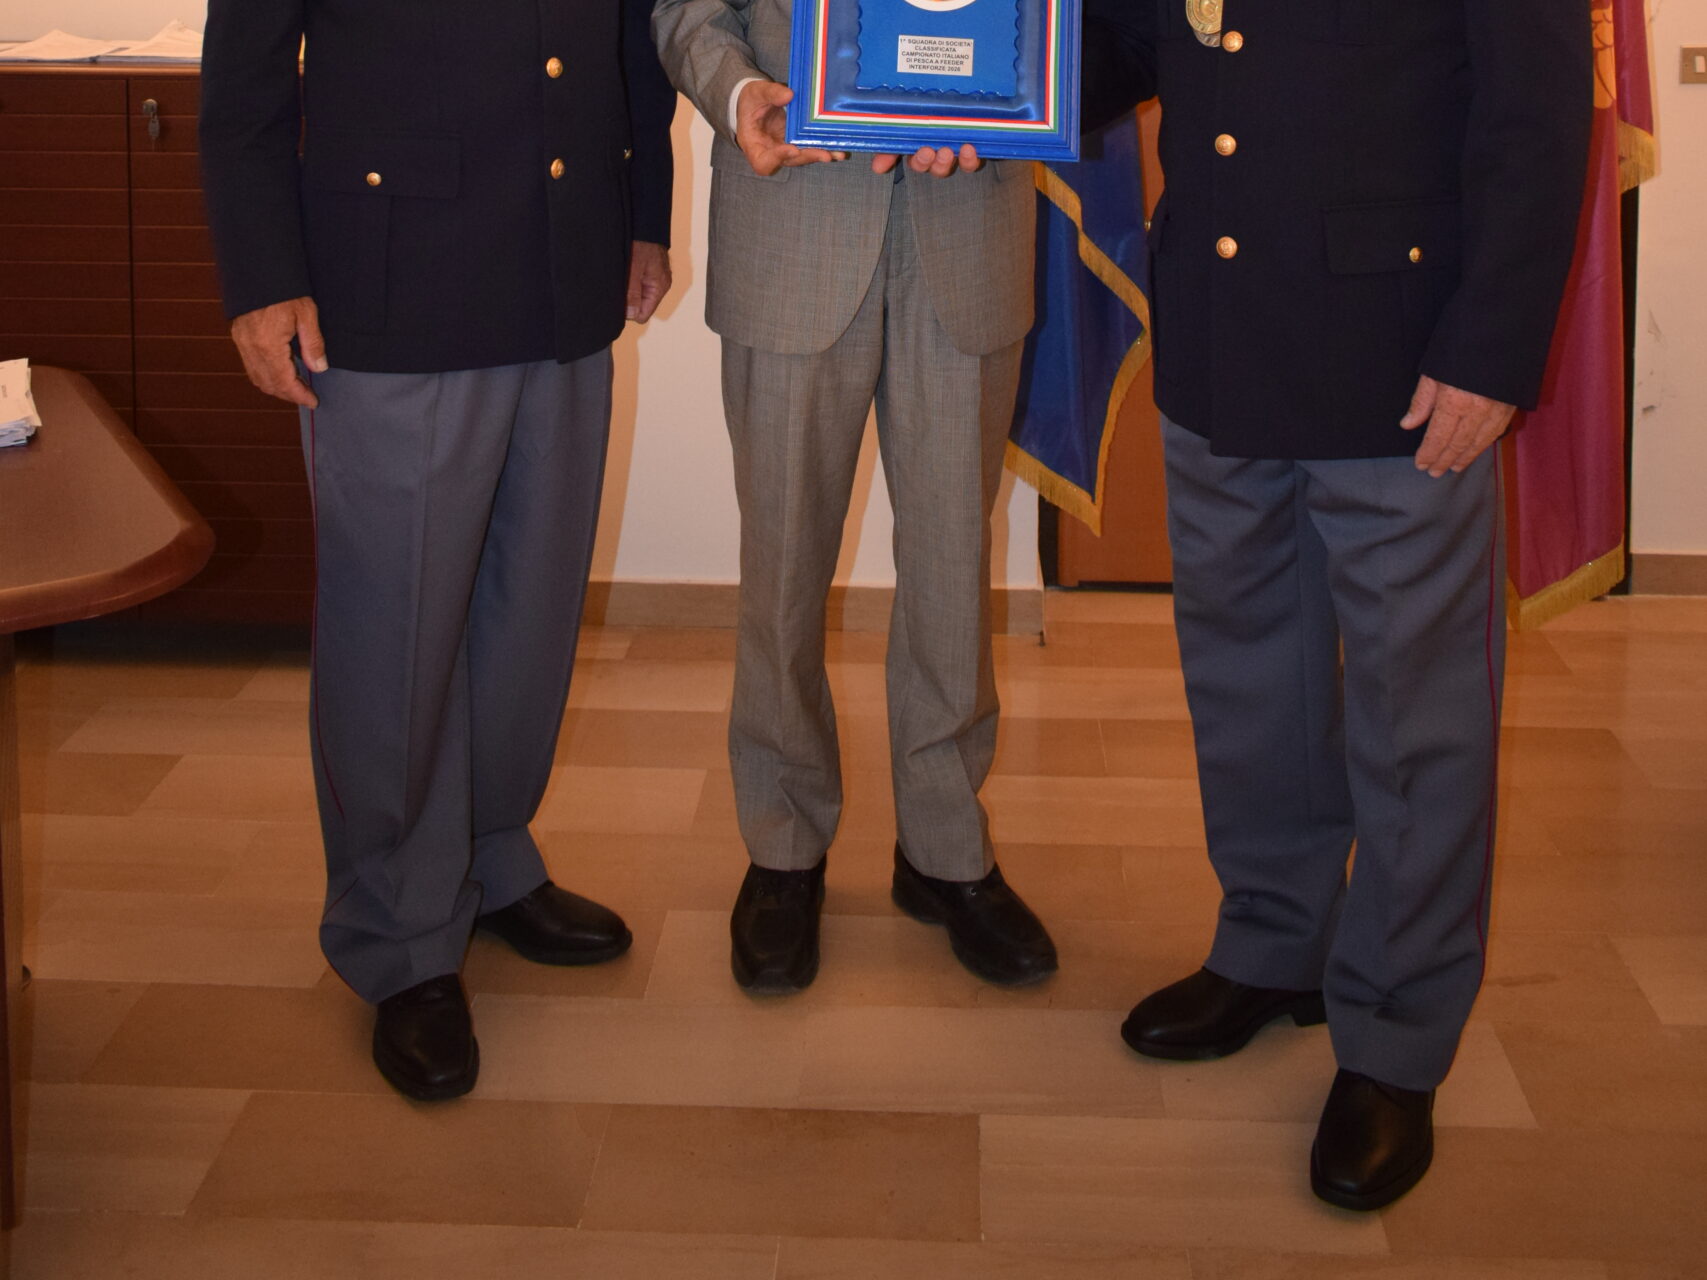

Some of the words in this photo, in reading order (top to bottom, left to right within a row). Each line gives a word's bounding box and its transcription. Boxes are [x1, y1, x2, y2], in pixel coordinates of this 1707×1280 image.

[907, 38, 937, 46] SQUADRA
[914, 45, 957, 53] CLASSIFICATA
[908, 64, 946, 72] INTERFORZE
